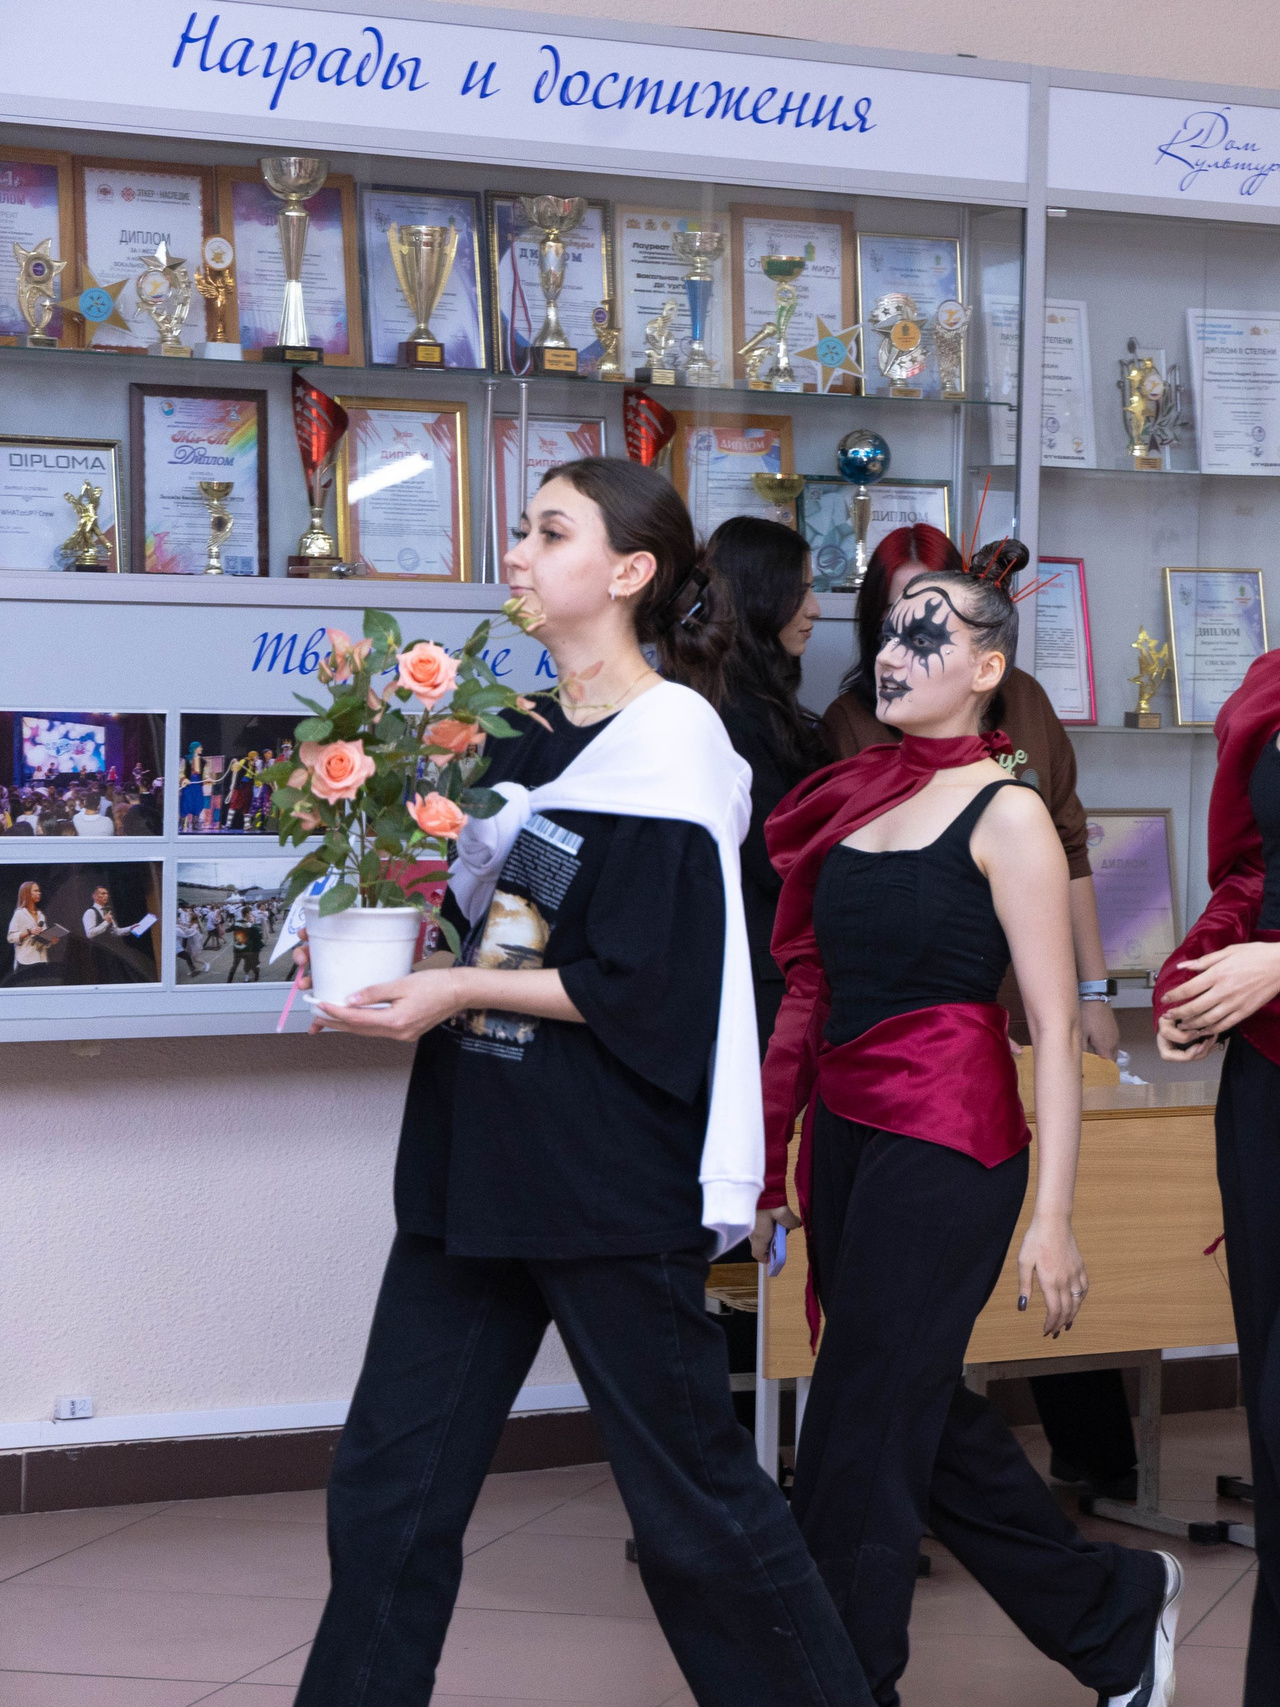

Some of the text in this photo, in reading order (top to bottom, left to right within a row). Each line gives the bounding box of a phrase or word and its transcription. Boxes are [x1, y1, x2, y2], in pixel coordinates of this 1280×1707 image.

[172, 12, 878, 133] Награды и достижения
[1181, 106, 1261, 152] Дом
[119, 229, 171, 246] ДИПЛОМ
[633, 242, 670, 251] Лауреат
[519, 247, 582, 263] ДИОМ
[719, 438, 765, 450] ДИПЛОМ
[9, 453, 106, 471] DIPLOMA
[527, 458, 569, 468] ДИПЛО
[872, 510, 929, 523] ДИПЛОМ
[1196, 627, 1241, 638] ДИПЛОМ
